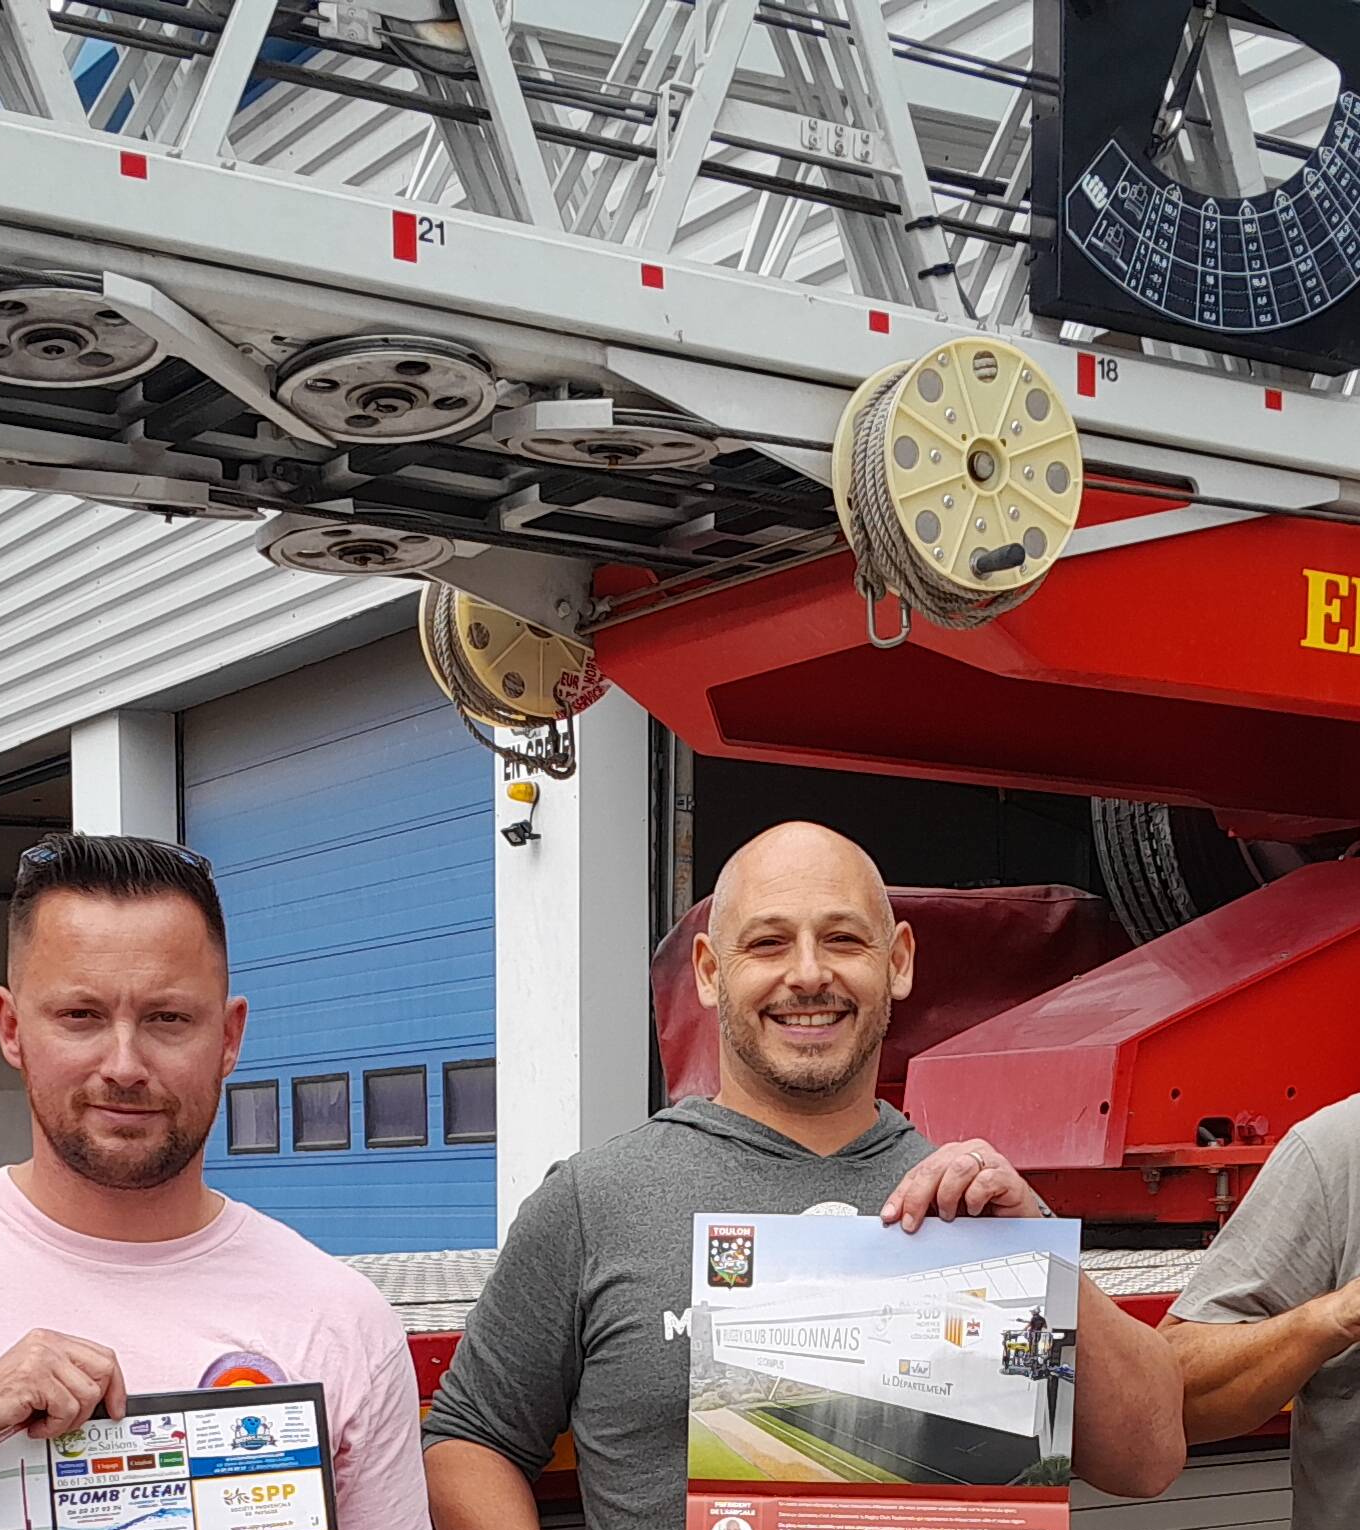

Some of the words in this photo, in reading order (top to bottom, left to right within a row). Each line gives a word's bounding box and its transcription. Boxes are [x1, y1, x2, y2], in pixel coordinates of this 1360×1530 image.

[418, 217, 446, 246] 21
[1097, 357, 1119, 381] 18
[713, 1227, 751, 1236] TOULON
[744, 1329, 766, 1345] CLUB
[769, 1327, 861, 1351] TOULONNAIS
[88, 1424, 101, 1441] Ô
[105, 1427, 123, 1441] Fil
[99, 1440, 138, 1451] Saisons
[131, 1483, 186, 1500] CLEAN
[251, 1484, 296, 1503] SPP
